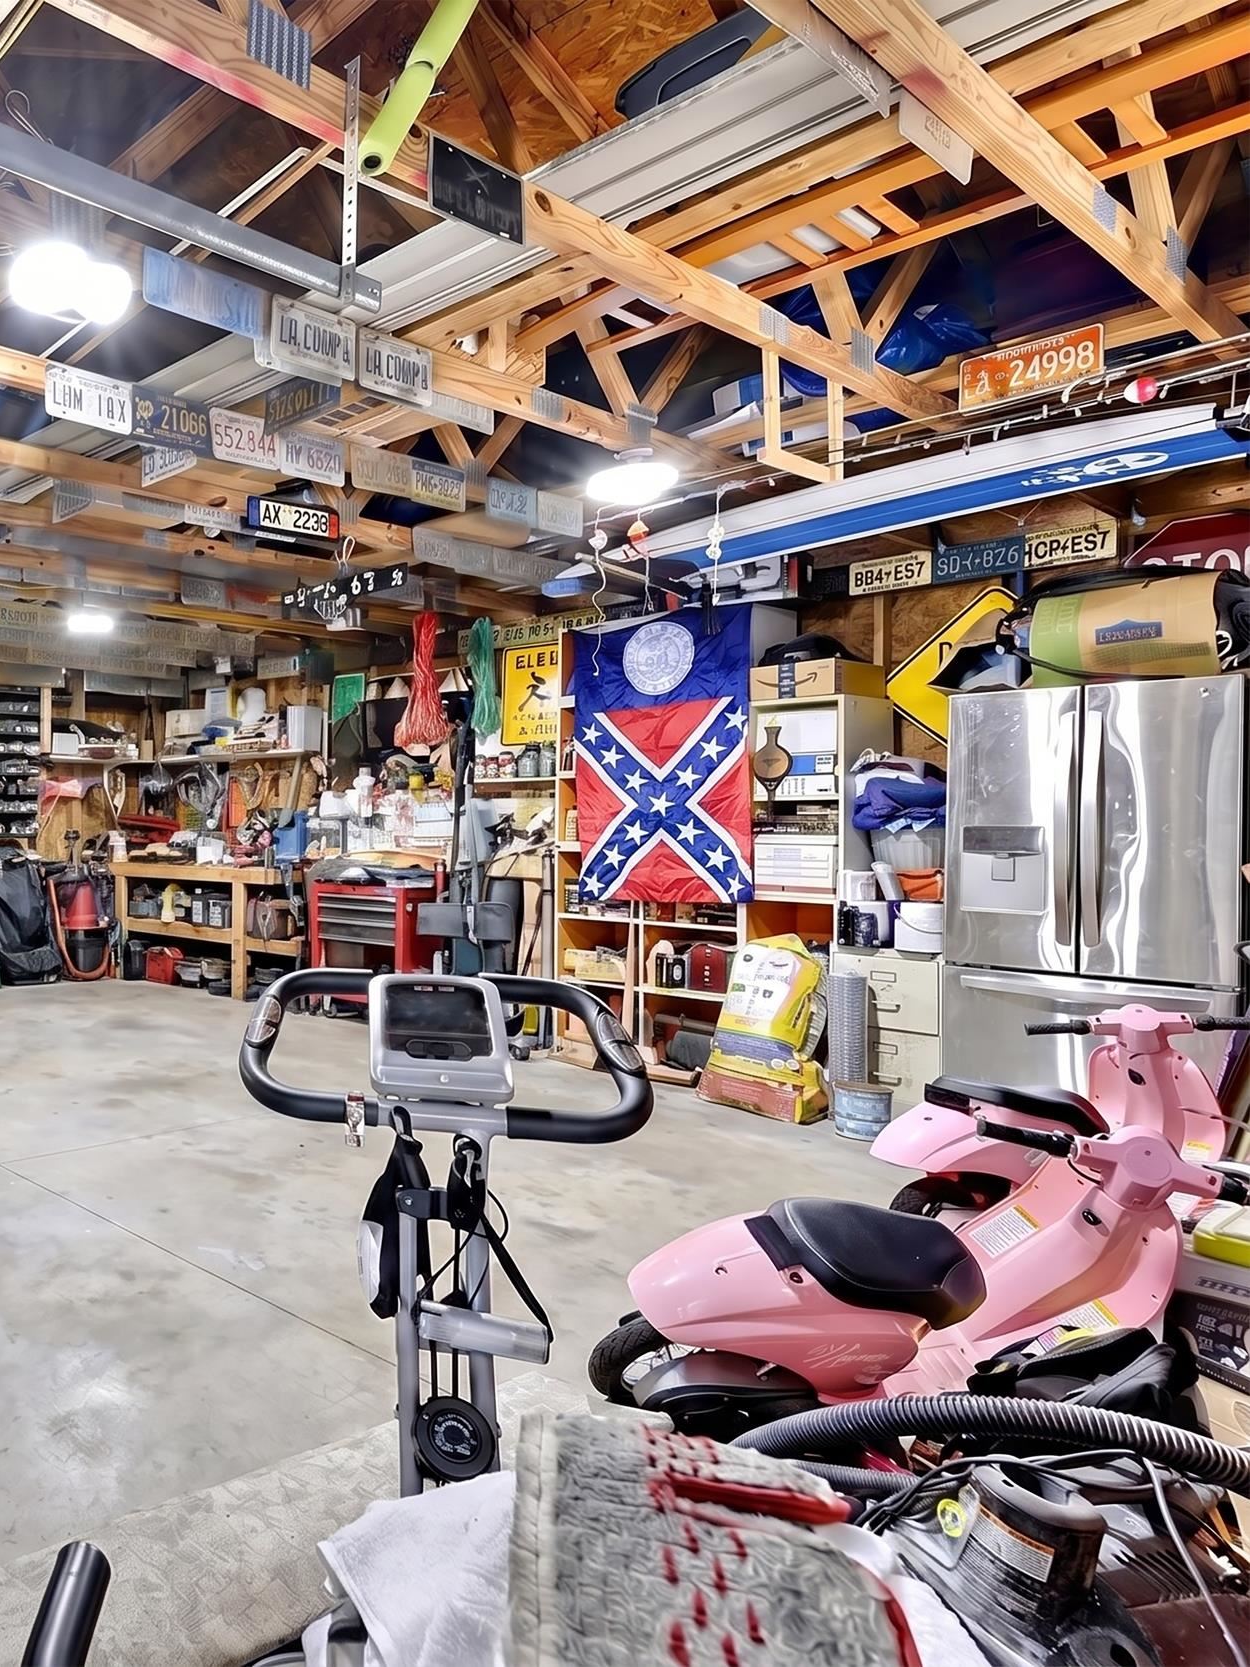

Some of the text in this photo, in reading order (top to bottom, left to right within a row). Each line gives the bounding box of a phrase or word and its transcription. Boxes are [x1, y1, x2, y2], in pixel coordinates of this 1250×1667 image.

[1009, 340, 1095, 388] 24998
[161, 404, 208, 438] 21066
[262, 502, 281, 526] AX
